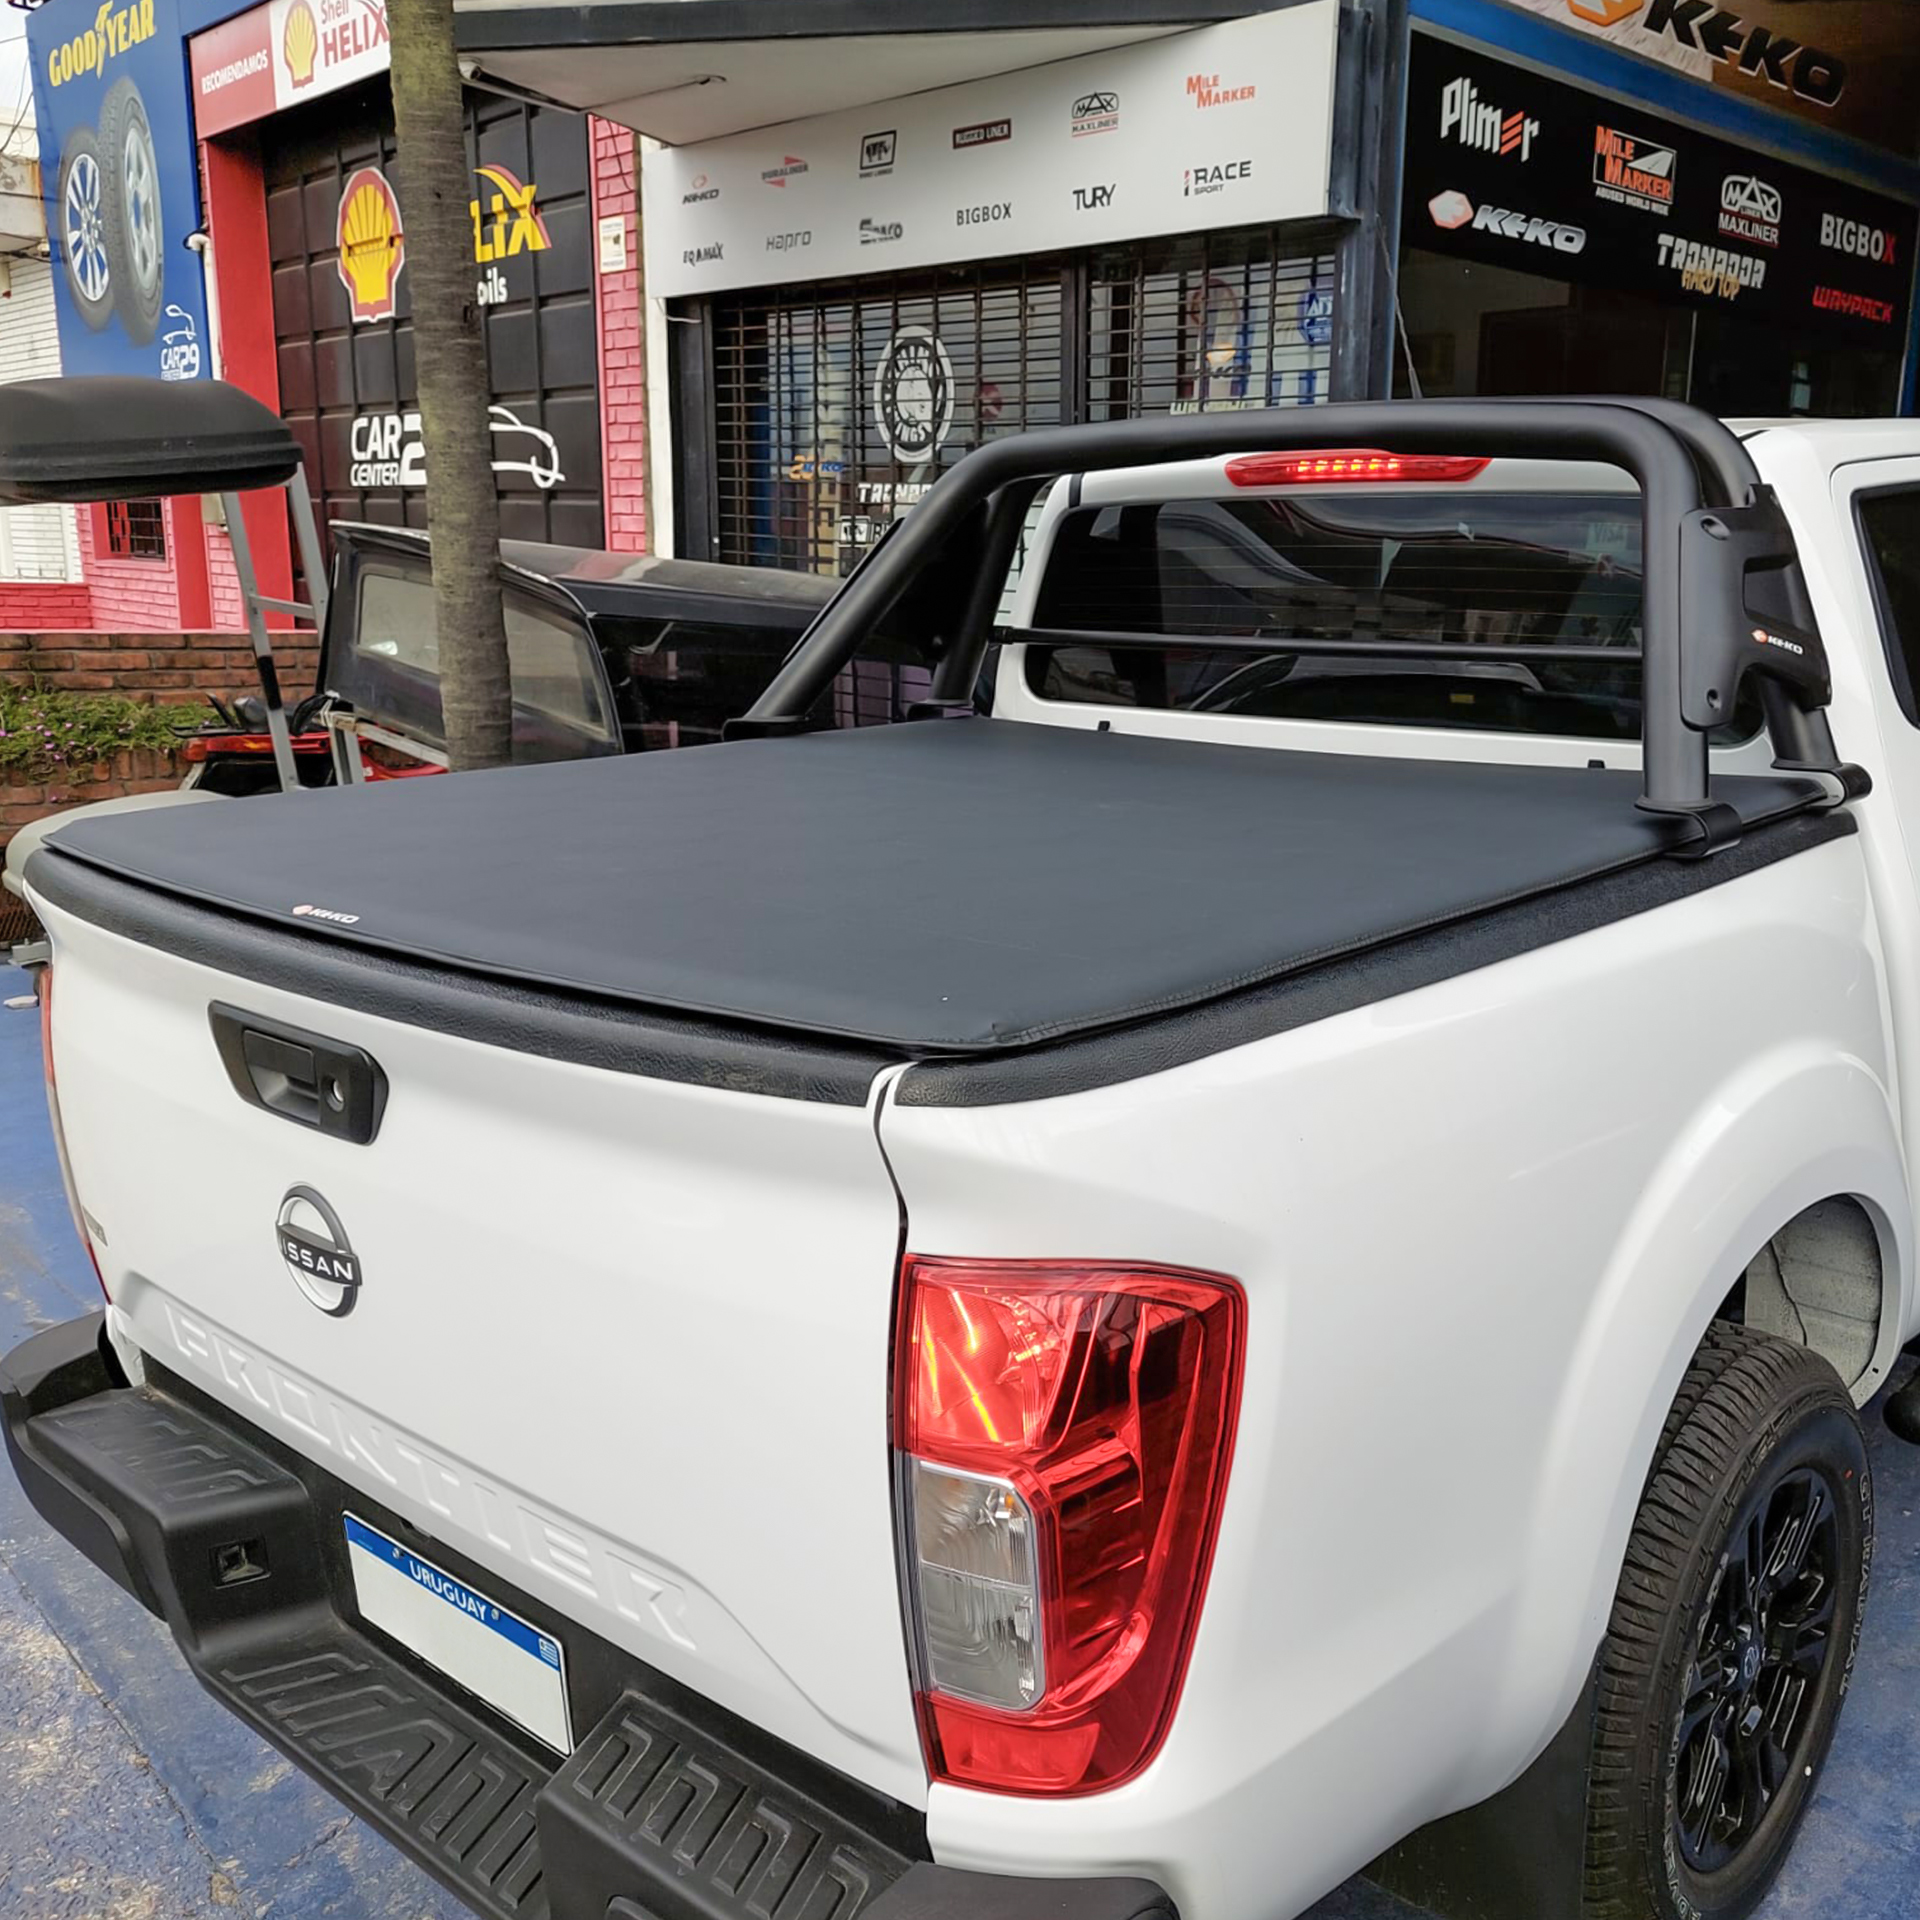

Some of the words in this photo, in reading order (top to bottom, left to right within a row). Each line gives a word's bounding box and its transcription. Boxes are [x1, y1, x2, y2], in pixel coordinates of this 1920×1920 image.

[320, 0, 350, 24] Shell
[49, 0, 156, 87] GOODYEAR
[322, 4, 390, 67] HELIX
[1643, 0, 1844, 107] KEKO
[202, 49, 268, 95] RECOMENDAMOS
[1187, 74, 1220, 95] MILE
[1074, 92, 1115, 116] MAX
[1197, 86, 1256, 109] MARKER
[1072, 116, 1120, 133] MAXLINER
[1594, 125, 1635, 161] MILE
[1072, 183, 1117, 210] TURY
[1193, 183, 1225, 196] SPORT
[1604, 154, 1672, 200] MARKER
[1724, 175, 1778, 218] MAX
[470, 167, 552, 264] LIX
[956, 202, 1012, 226] BIGBOX
[1471, 204, 1587, 254] KEKO
[1718, 212, 1780, 246] MAXLINER
[1820, 211, 1896, 265] BIGBOX
[1657, 233, 1767, 289] TRONADOR
[477, 267, 508, 306] oils
[1681, 268, 1716, 296] HARD
[1717, 274, 1741, 301] TOP
[1812, 285, 1894, 324] WAYPACK
[160, 346, 181, 370] CAR
[179, 343, 200, 379] 29
[351, 414, 402, 461] CAR
[400, 413, 428, 486] 2
[350, 461, 401, 487] CENTER
[164, 1301, 698, 1651] FRONTIER
[409, 1559, 488, 1621] URUGUAY
